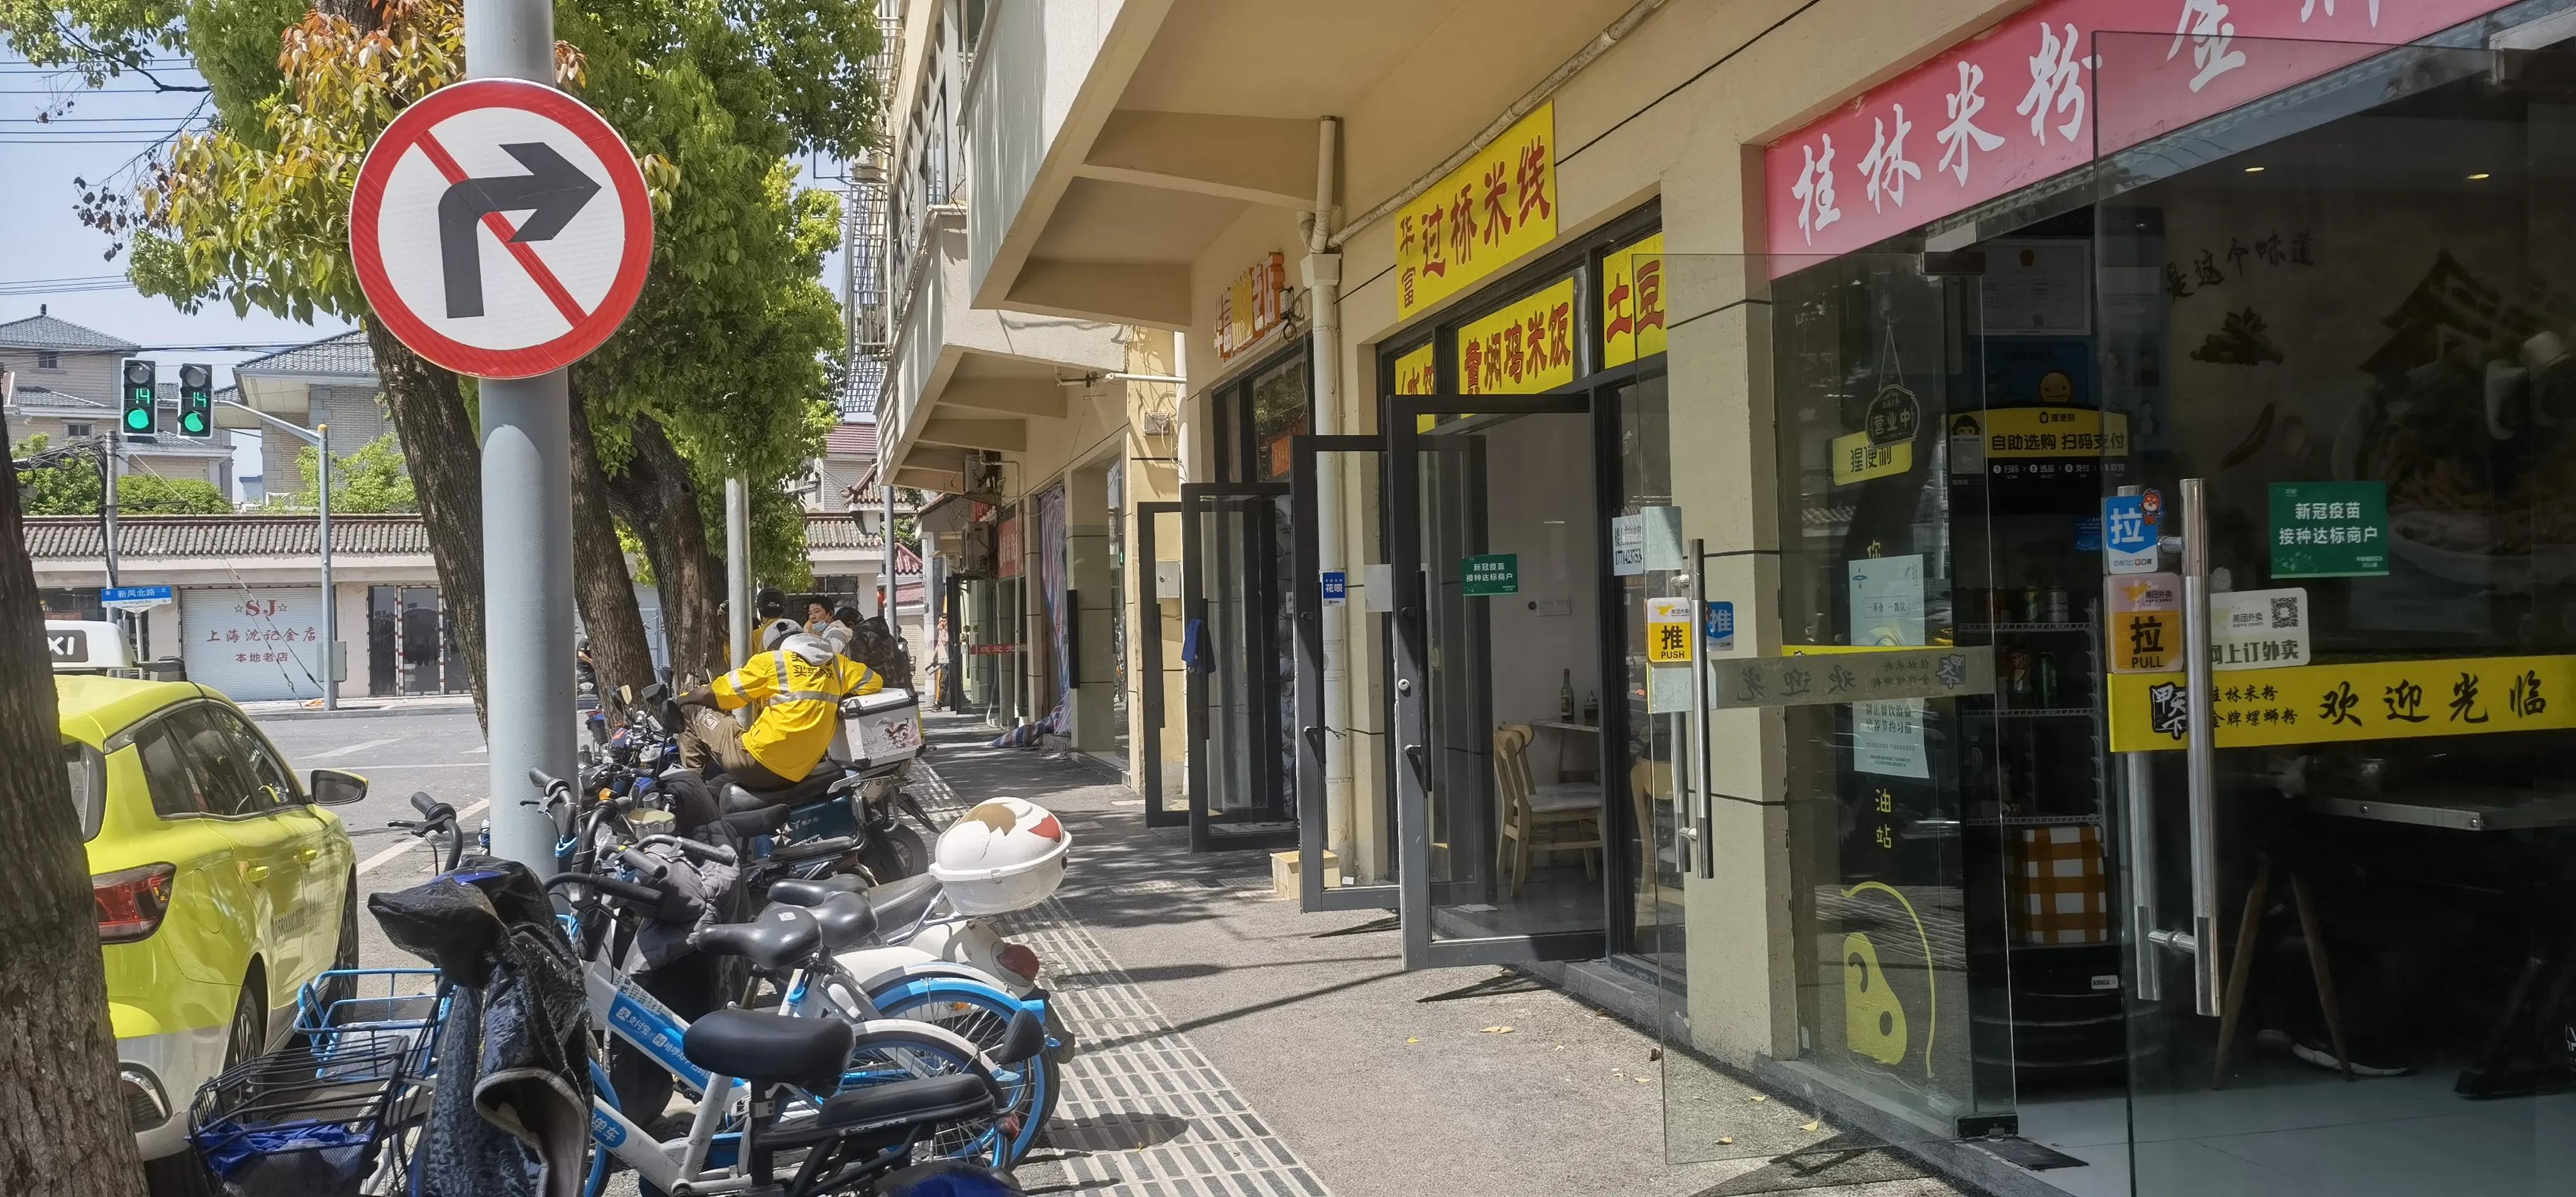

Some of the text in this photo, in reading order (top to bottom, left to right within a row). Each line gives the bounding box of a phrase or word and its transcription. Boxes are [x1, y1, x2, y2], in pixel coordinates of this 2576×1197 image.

[1791, 21, 2103, 246] 桂林米粉
[1421, 135, 1551, 279] 过桥米线
[1399, 215, 1416, 309] 华富
[1606, 259, 1665, 343] 土豆
[1465, 302, 1571, 394] 黄焖鸡米饭
[136, 388, 150, 404] 14
[193, 392, 207, 407] 14
[1874, 409, 1911, 434] 营业中
[1992, 432, 2125, 451] 自助选购 扫码支付
[2295, 501, 2361, 520] 新冠疫苗
[2110, 507, 2144, 545] 拉
[2279, 526, 2378, 546] 接种达标商户
[1466, 573, 1513, 582] 接种达标商户
[1474, 563, 1505, 571] 新冠疫苗
[1325, 583, 1343, 593] 花呗
[1709, 609, 1733, 632] 推
[1661, 625, 1684, 650] 推
[2130, 615, 2164, 655] 拉
[236, 652, 289, 663] 本地老店
[1661, 651, 1685, 659] PUSH
[2131, 657, 2164, 669] PULL
[2319, 670, 2546, 727] 欢迎光临
[1875, 788, 1892, 849] 油站
[626, 1015, 652, 1036] 支付宝
[592, 1113, 621, 1142] 单车
